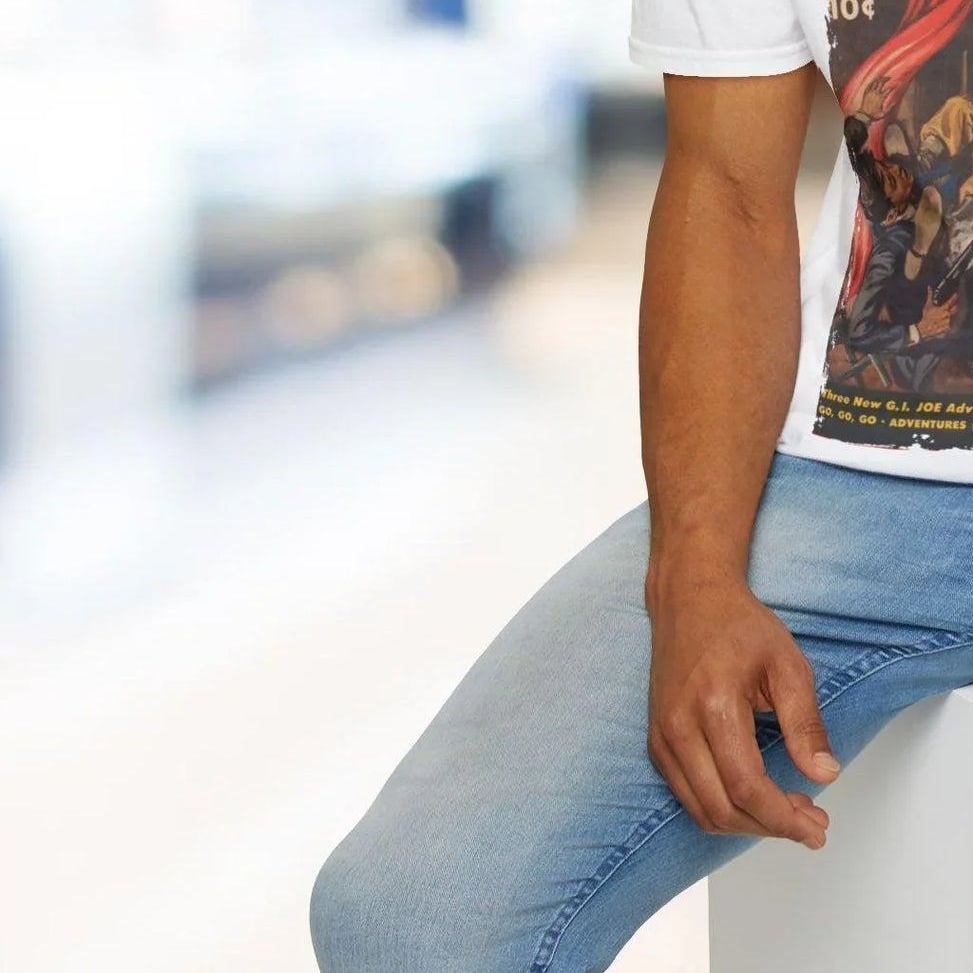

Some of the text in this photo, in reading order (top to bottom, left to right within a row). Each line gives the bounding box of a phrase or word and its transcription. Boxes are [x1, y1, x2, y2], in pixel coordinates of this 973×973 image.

[853, 396, 883, 409] New
[916, 402, 942, 413] JOE
[837, 410, 855, 423] GO,
[859, 414, 877, 425] GO
[889, 418, 966, 430] ADVENTURES
